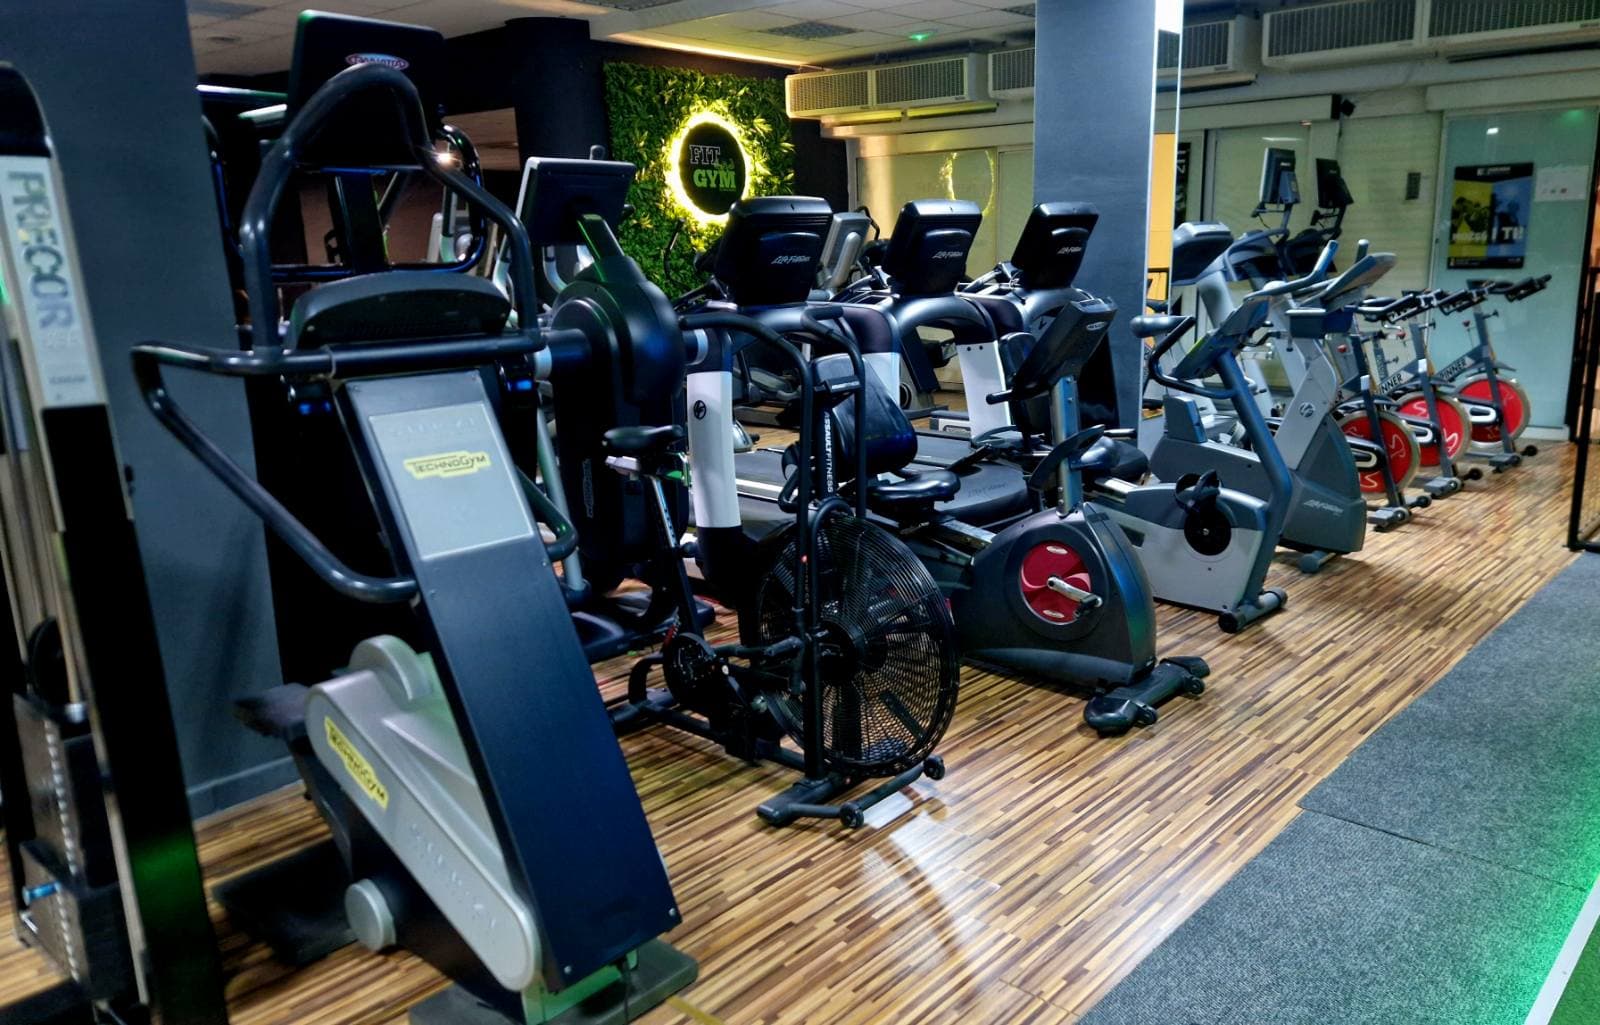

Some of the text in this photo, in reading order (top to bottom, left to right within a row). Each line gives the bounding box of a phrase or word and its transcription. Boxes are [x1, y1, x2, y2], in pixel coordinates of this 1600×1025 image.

[689, 144, 721, 165] FIT
[693, 168, 736, 188] GYM
[8, 170, 74, 328] PRECOR
